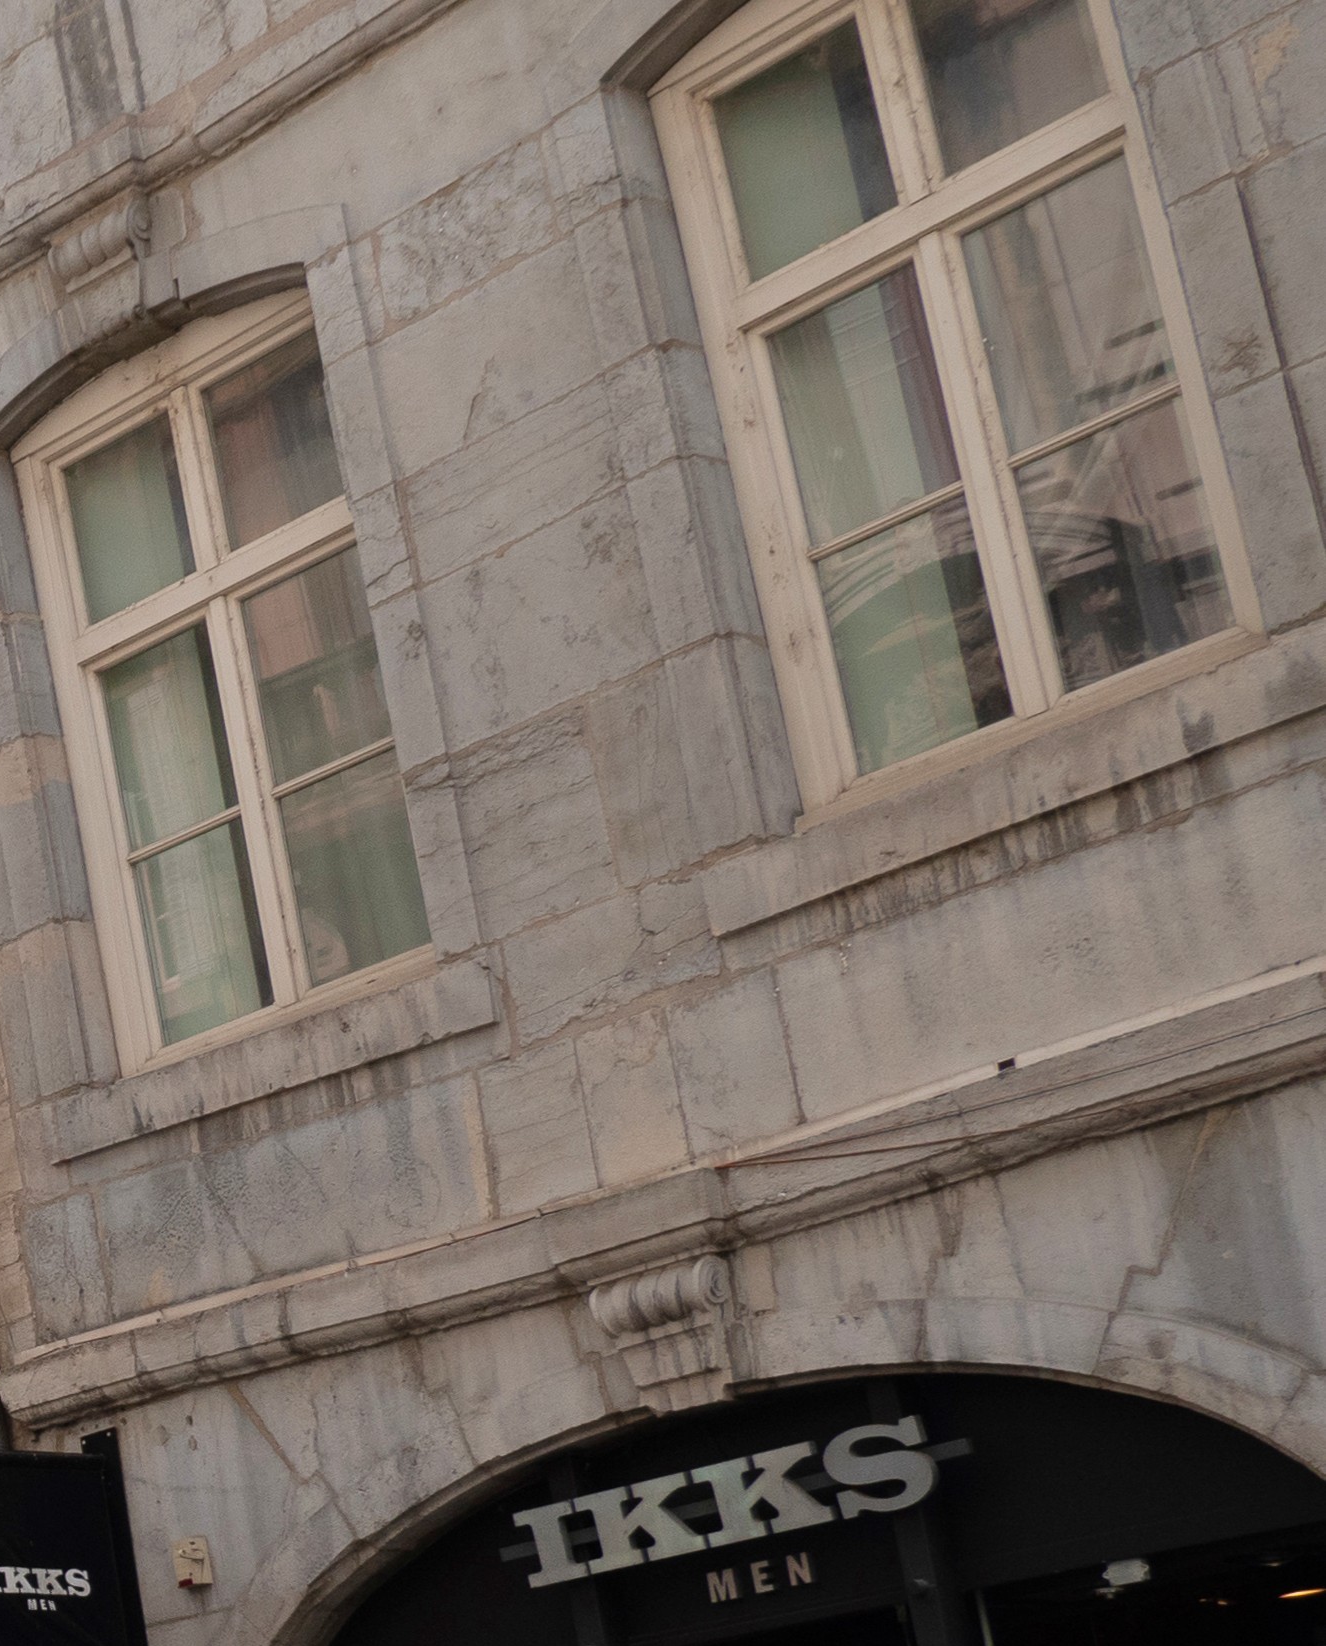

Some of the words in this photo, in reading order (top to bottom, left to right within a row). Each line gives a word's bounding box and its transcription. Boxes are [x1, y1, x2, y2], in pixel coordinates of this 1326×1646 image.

[512, 1415, 939, 1588] IKKS
[707, 1552, 813, 1603] MEN
[27, 1597, 57, 1612] MEN
